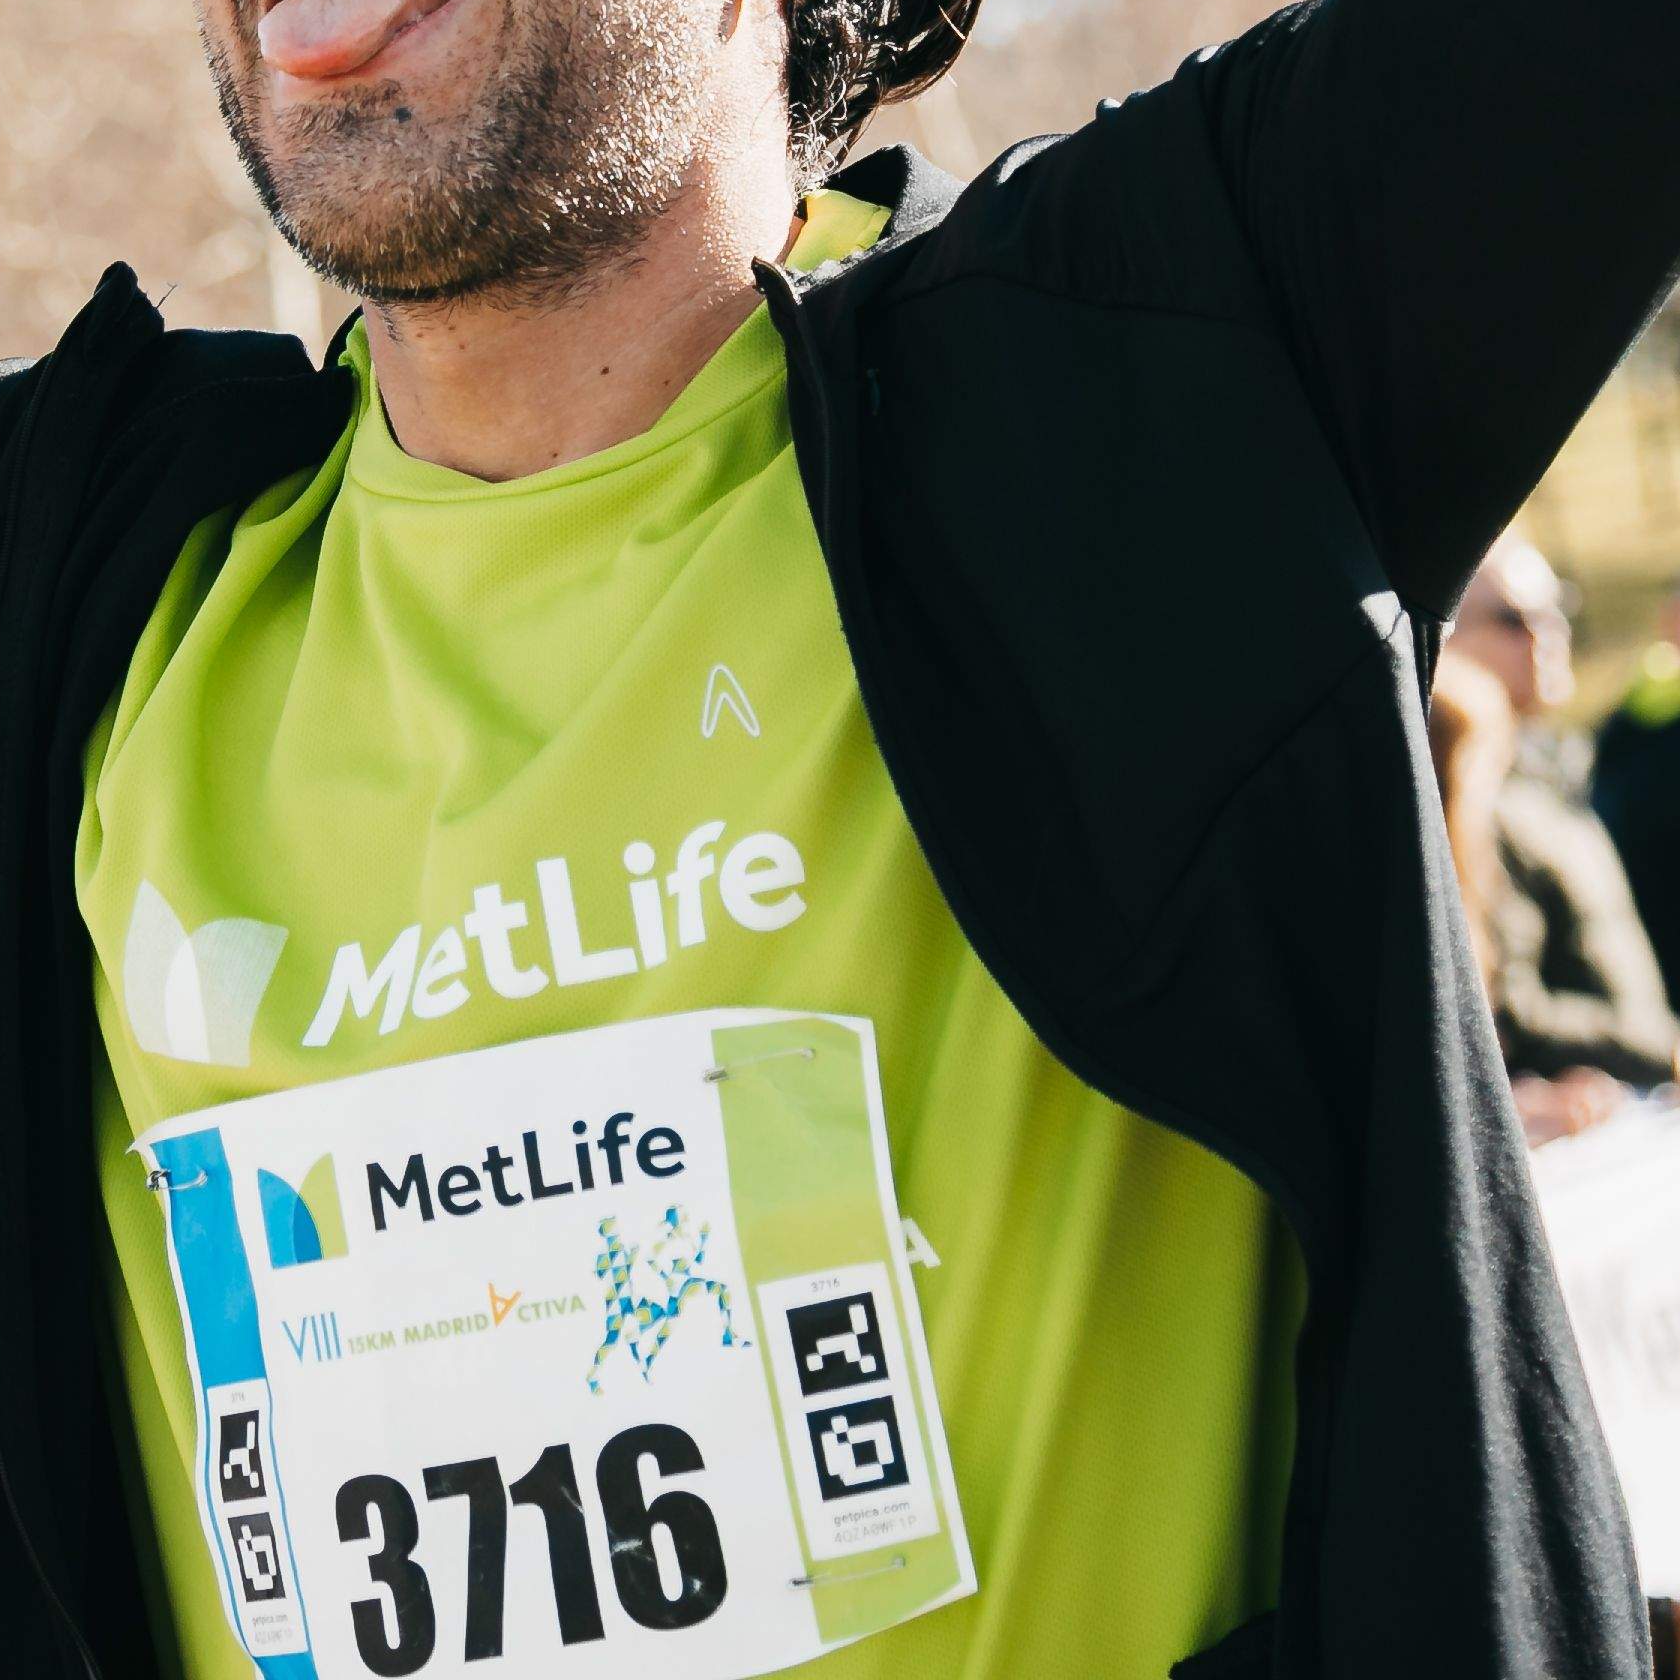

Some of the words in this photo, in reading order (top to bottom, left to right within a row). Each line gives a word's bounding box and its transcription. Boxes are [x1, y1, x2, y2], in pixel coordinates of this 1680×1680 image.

[304, 820, 807, 1047] MetLife
[366, 1112, 687, 1232] MetLife
[282, 1311, 342, 1363] VIII
[348, 1331, 396, 1355] 15KM
[404, 1313, 489, 1346] MADRID
[335, 1422, 730, 1678] 3716
[834, 1501, 910, 1527] getpica.com
